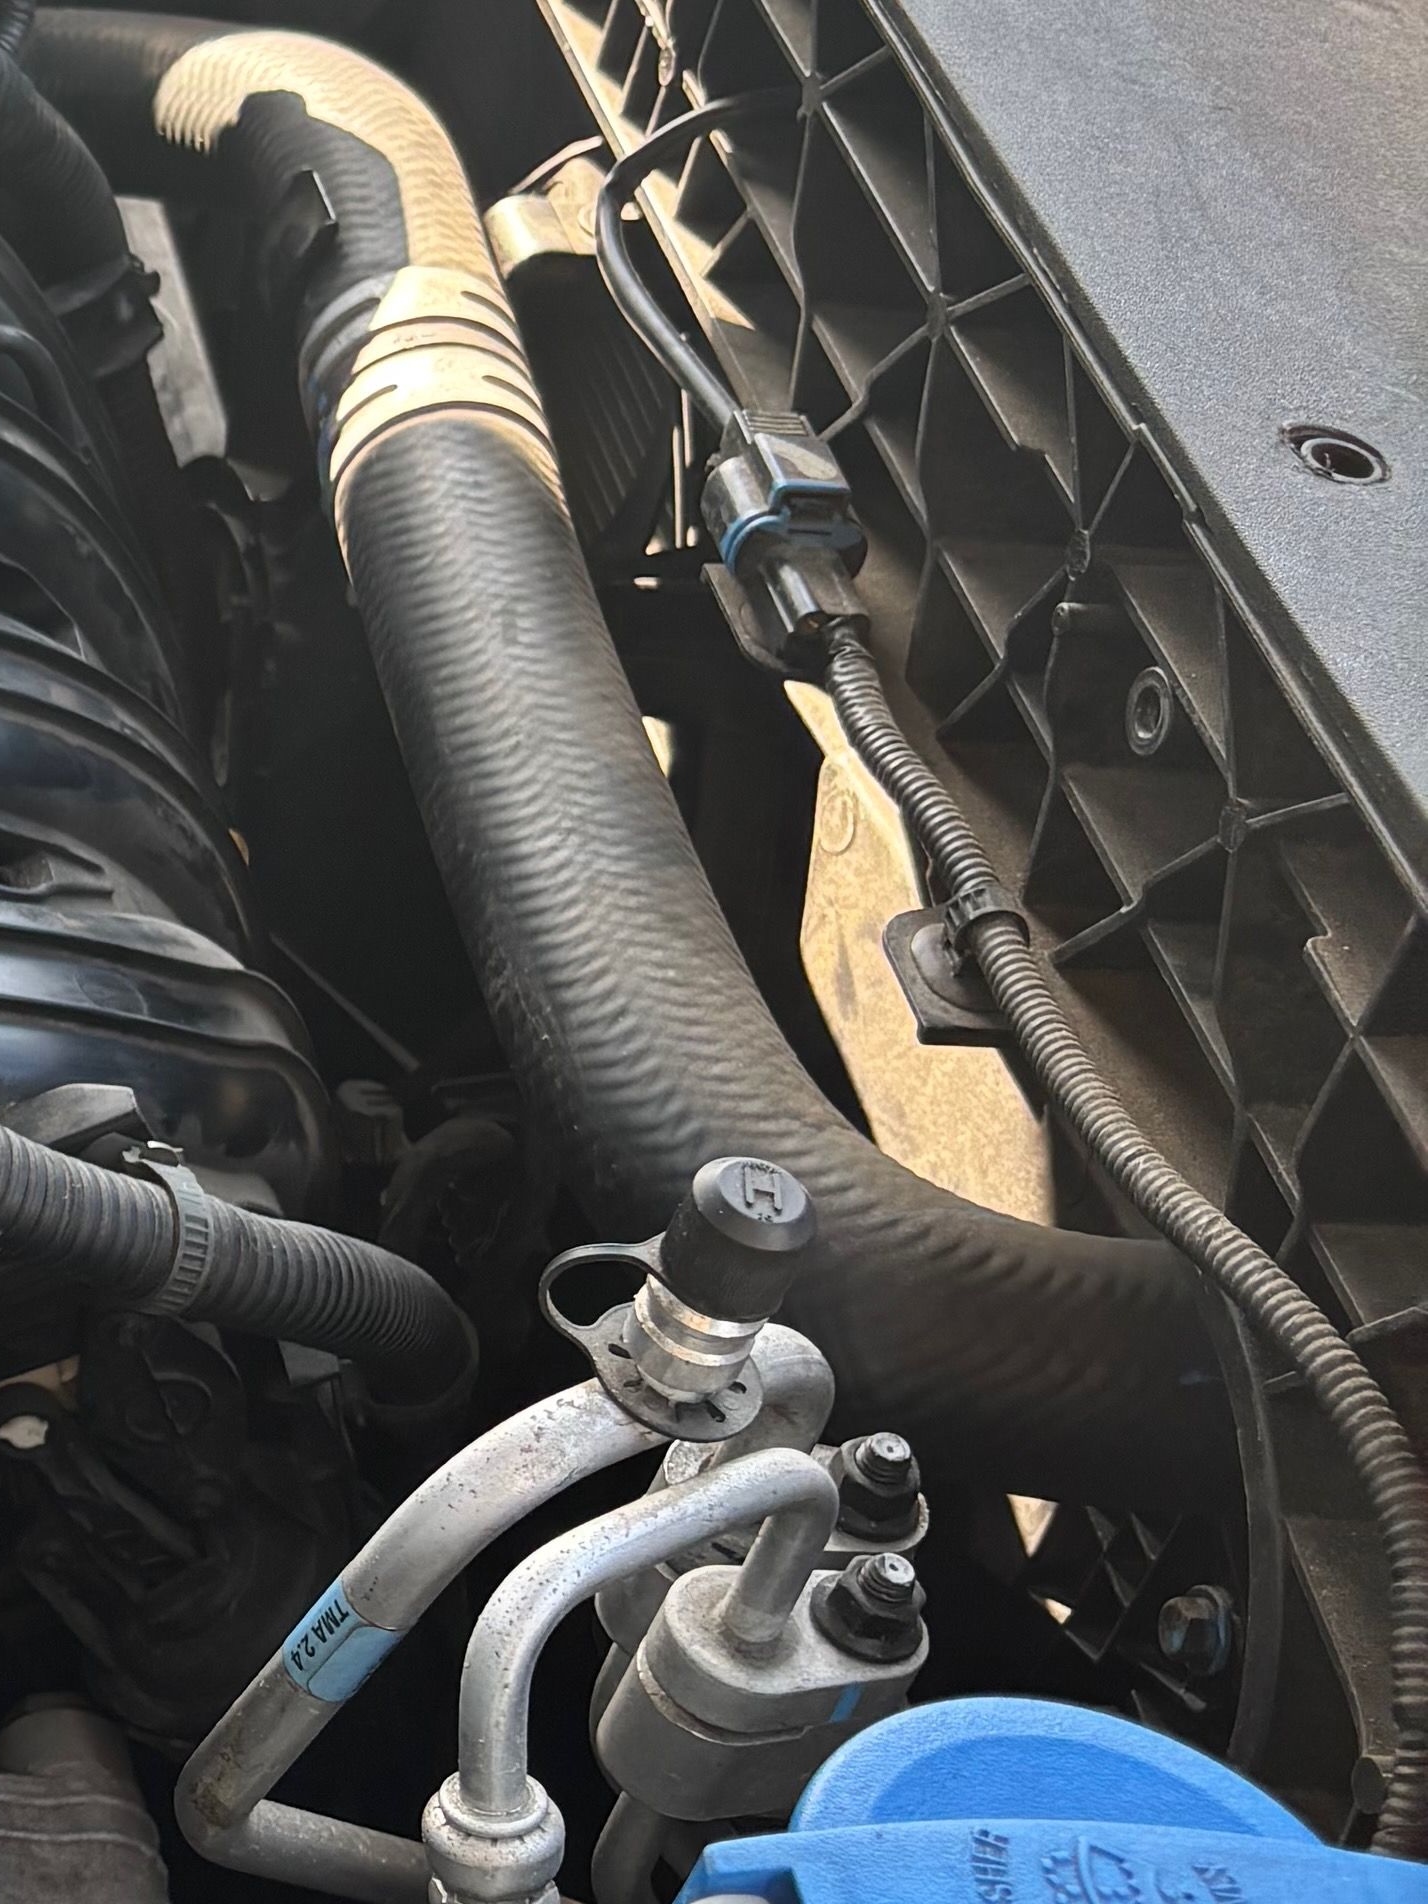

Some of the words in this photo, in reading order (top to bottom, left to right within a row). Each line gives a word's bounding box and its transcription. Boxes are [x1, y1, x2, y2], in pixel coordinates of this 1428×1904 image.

[743, 1166, 783, 1216] H
[311, 1599, 351, 1645] TMA
[290, 1632, 316, 1672] 2.4
